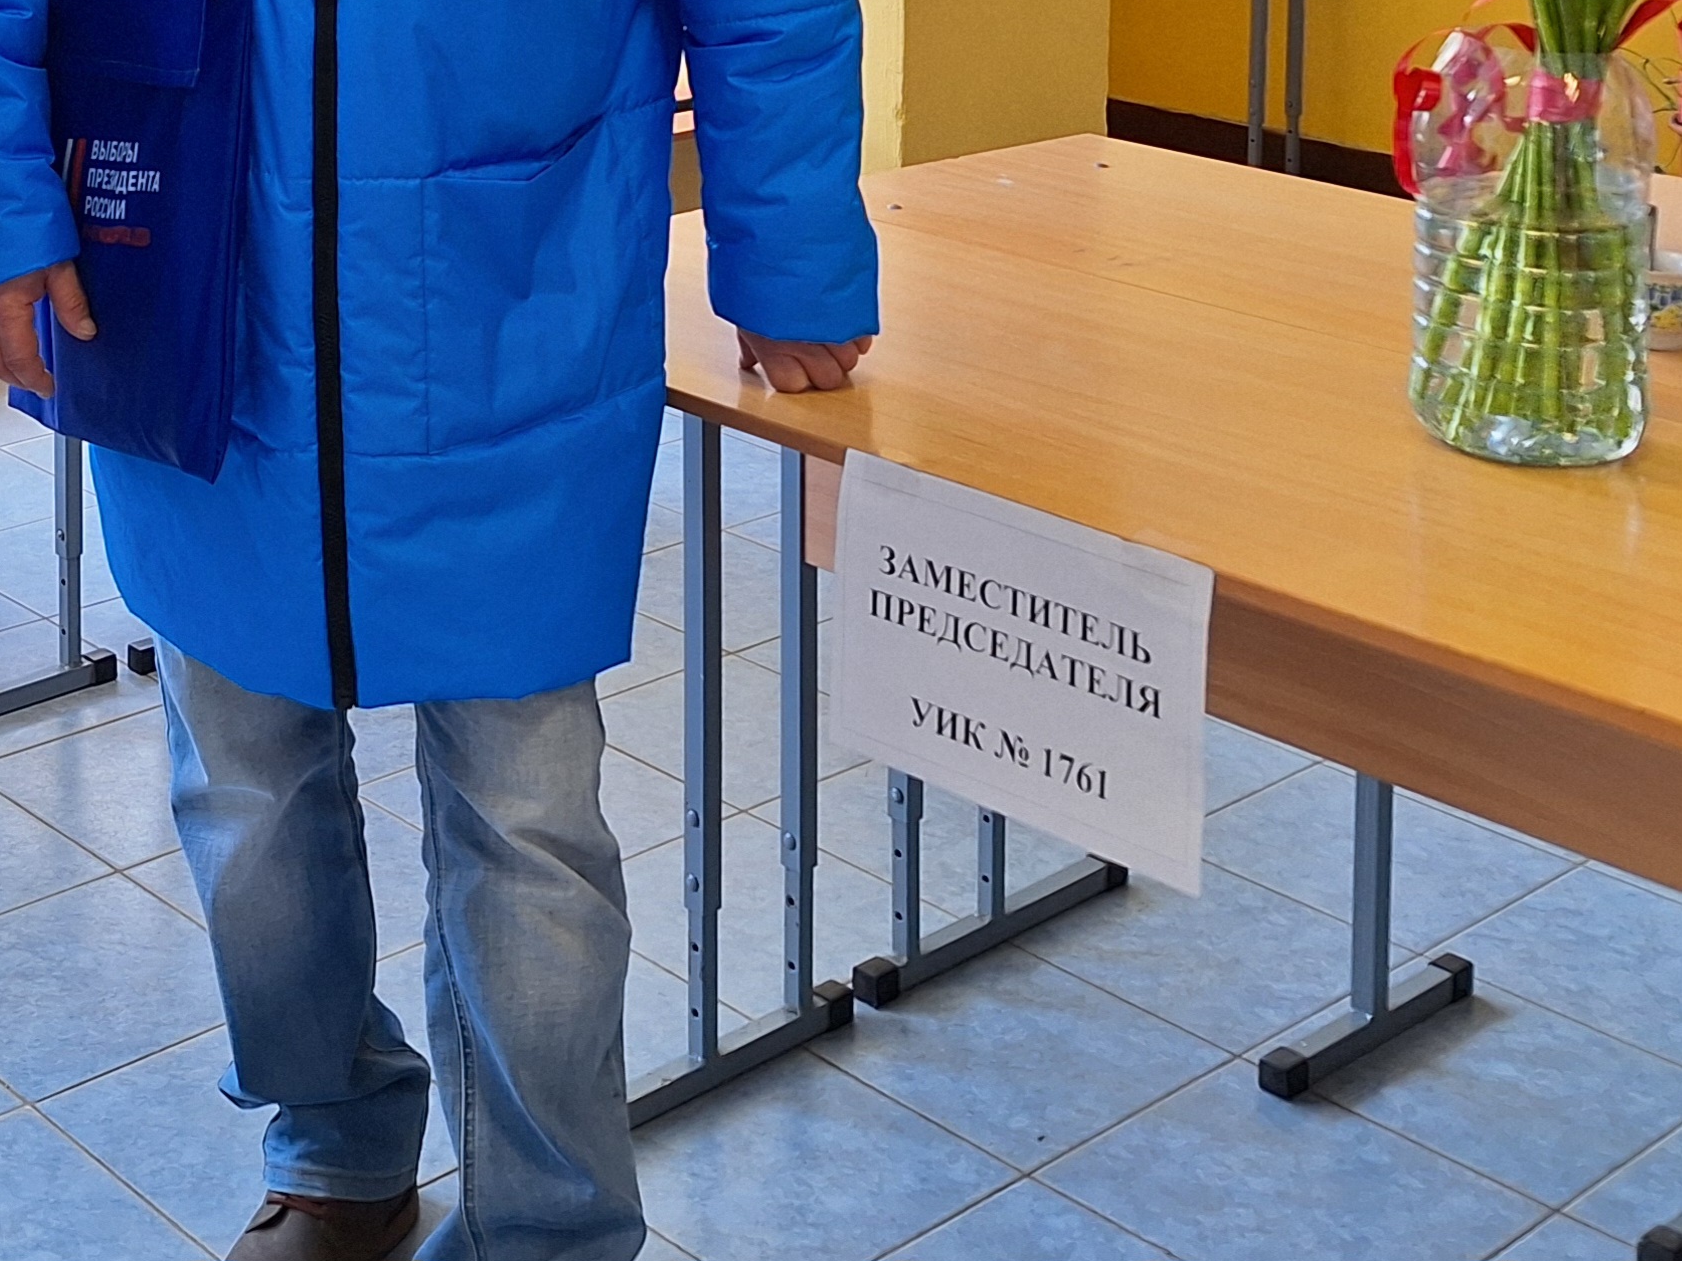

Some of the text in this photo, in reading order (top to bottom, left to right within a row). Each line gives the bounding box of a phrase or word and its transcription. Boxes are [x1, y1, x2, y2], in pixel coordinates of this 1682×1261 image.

[86, 168, 161, 195] ПРЕЗИДЕНТА
[91, 139, 139, 163] ВЫБОРЫ
[84, 196, 127, 220] РОССИИ
[879, 544, 1152, 665] ЗАМЕСТИТЕЛЬ
[869, 588, 1162, 720] ПРЕДСЕДАТЕЛЯ
[909, 696, 1109, 801] УИК № 1761
